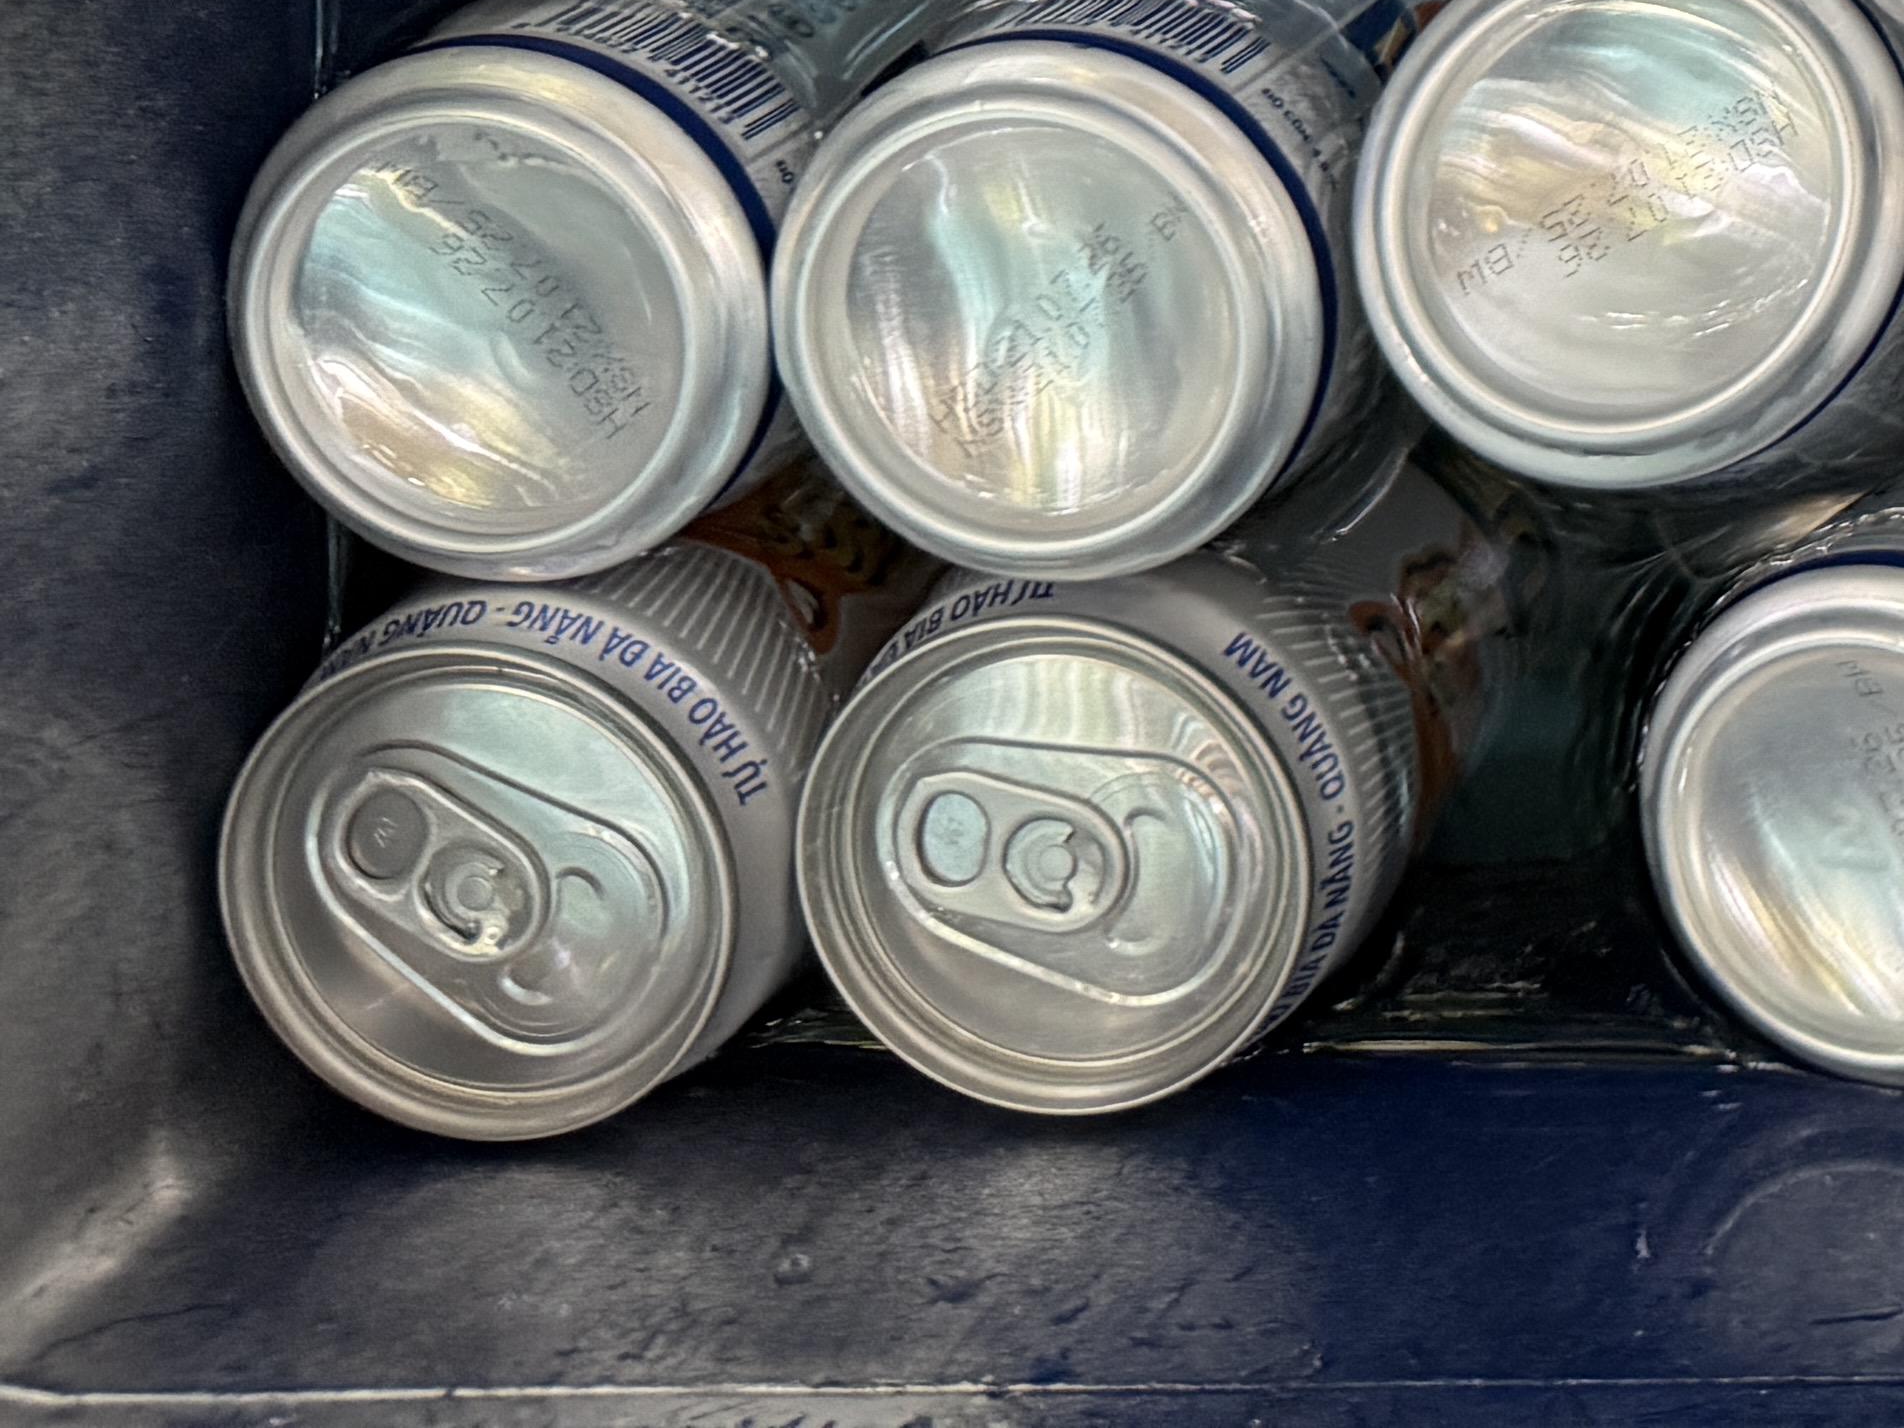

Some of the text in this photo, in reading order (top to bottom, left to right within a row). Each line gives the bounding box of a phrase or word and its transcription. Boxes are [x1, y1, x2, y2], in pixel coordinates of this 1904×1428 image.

[662, 61, 737, 127] 411213
[427, 225, 630, 441] HSD:21.07.26
[950, 579, 1015, 619] HÀO
[382, 600, 768, 806] TỰ HÀO BIA ĐÀ NẴNG QUẢNG
[1222, 631, 1355, 909] NẴNG QUẢNG NAM
